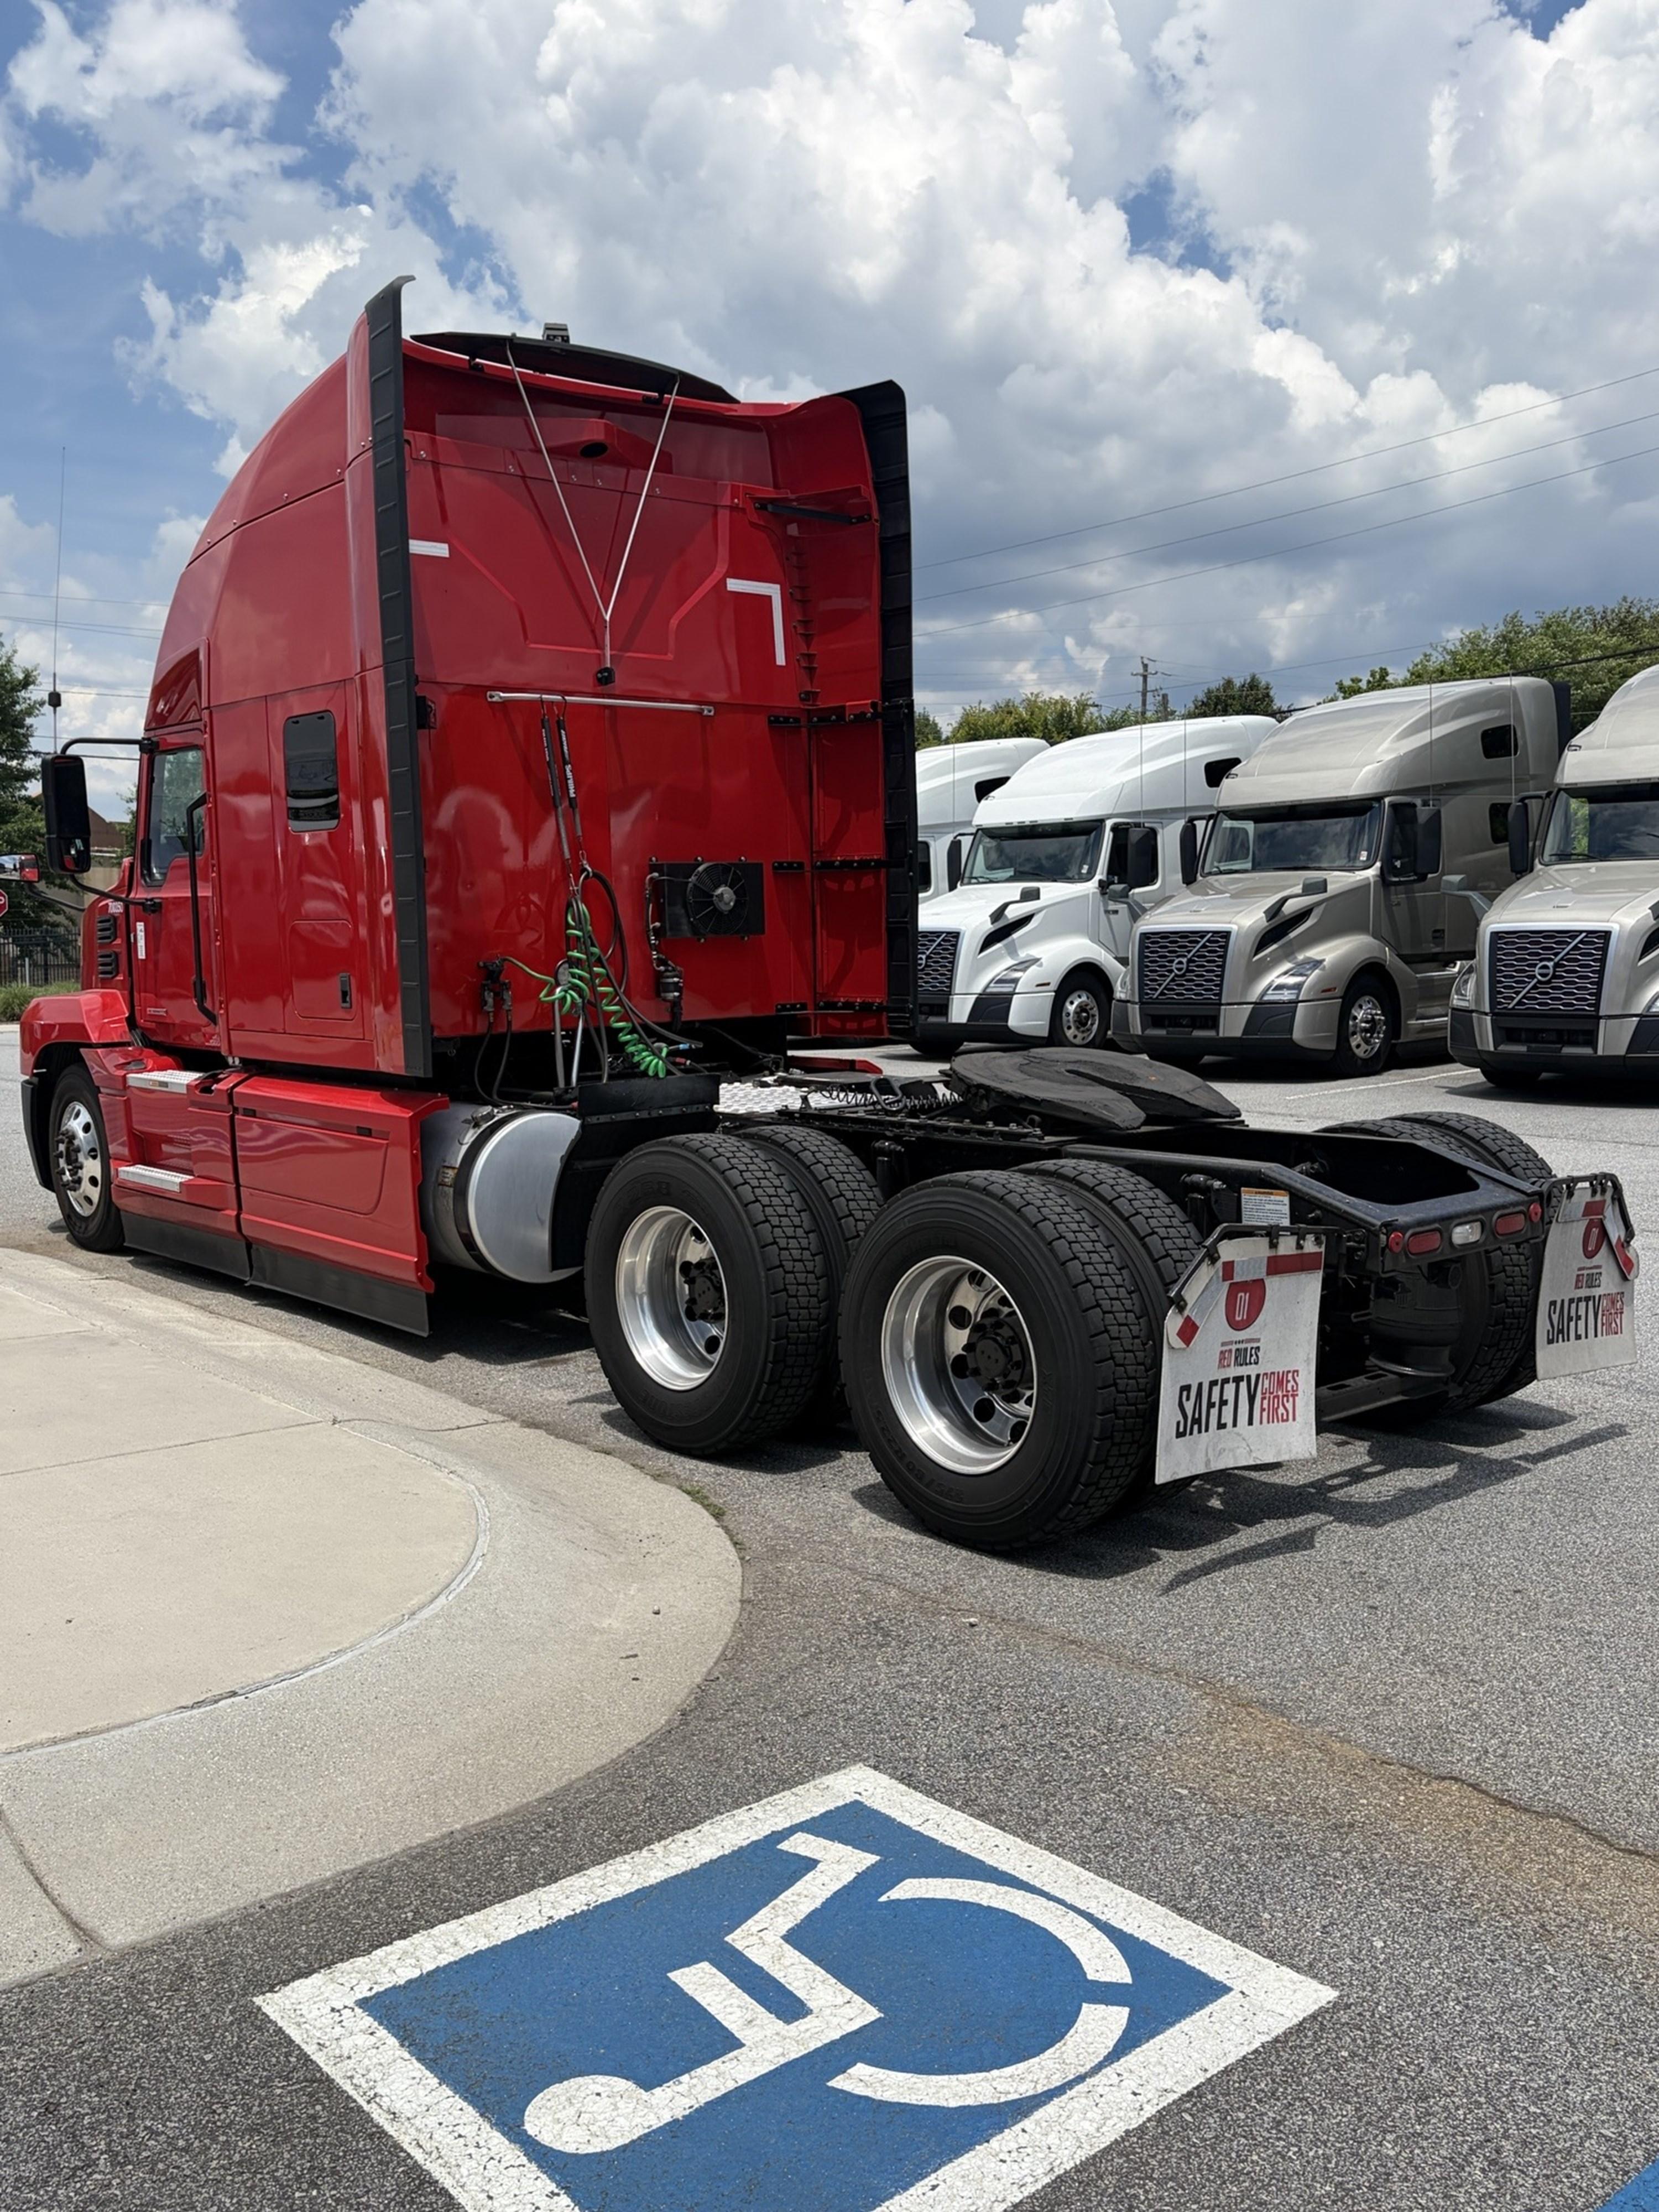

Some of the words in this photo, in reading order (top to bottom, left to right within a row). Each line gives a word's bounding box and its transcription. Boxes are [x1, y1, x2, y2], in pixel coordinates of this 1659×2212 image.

[1588, 1228, 1599, 1251] 01
[1574, 1273, 1585, 1290] RED
[1585, 1272, 1602, 1289] RULES
[1235, 1292, 1250, 1321] 01
[1601, 1291, 1625, 1312] COMES
[1547, 1294, 1602, 1345] SAFETY
[1601, 1311, 1624, 1337] FIRST
[1218, 1348, 1233, 1370] RED
[1234, 1345, 1260, 1368] RULES
[1261, 1369, 1300, 1395] COMES
[1175, 1373, 1261, 1439] SAFETY
[1259, 1393, 1299, 1426] FIRST
